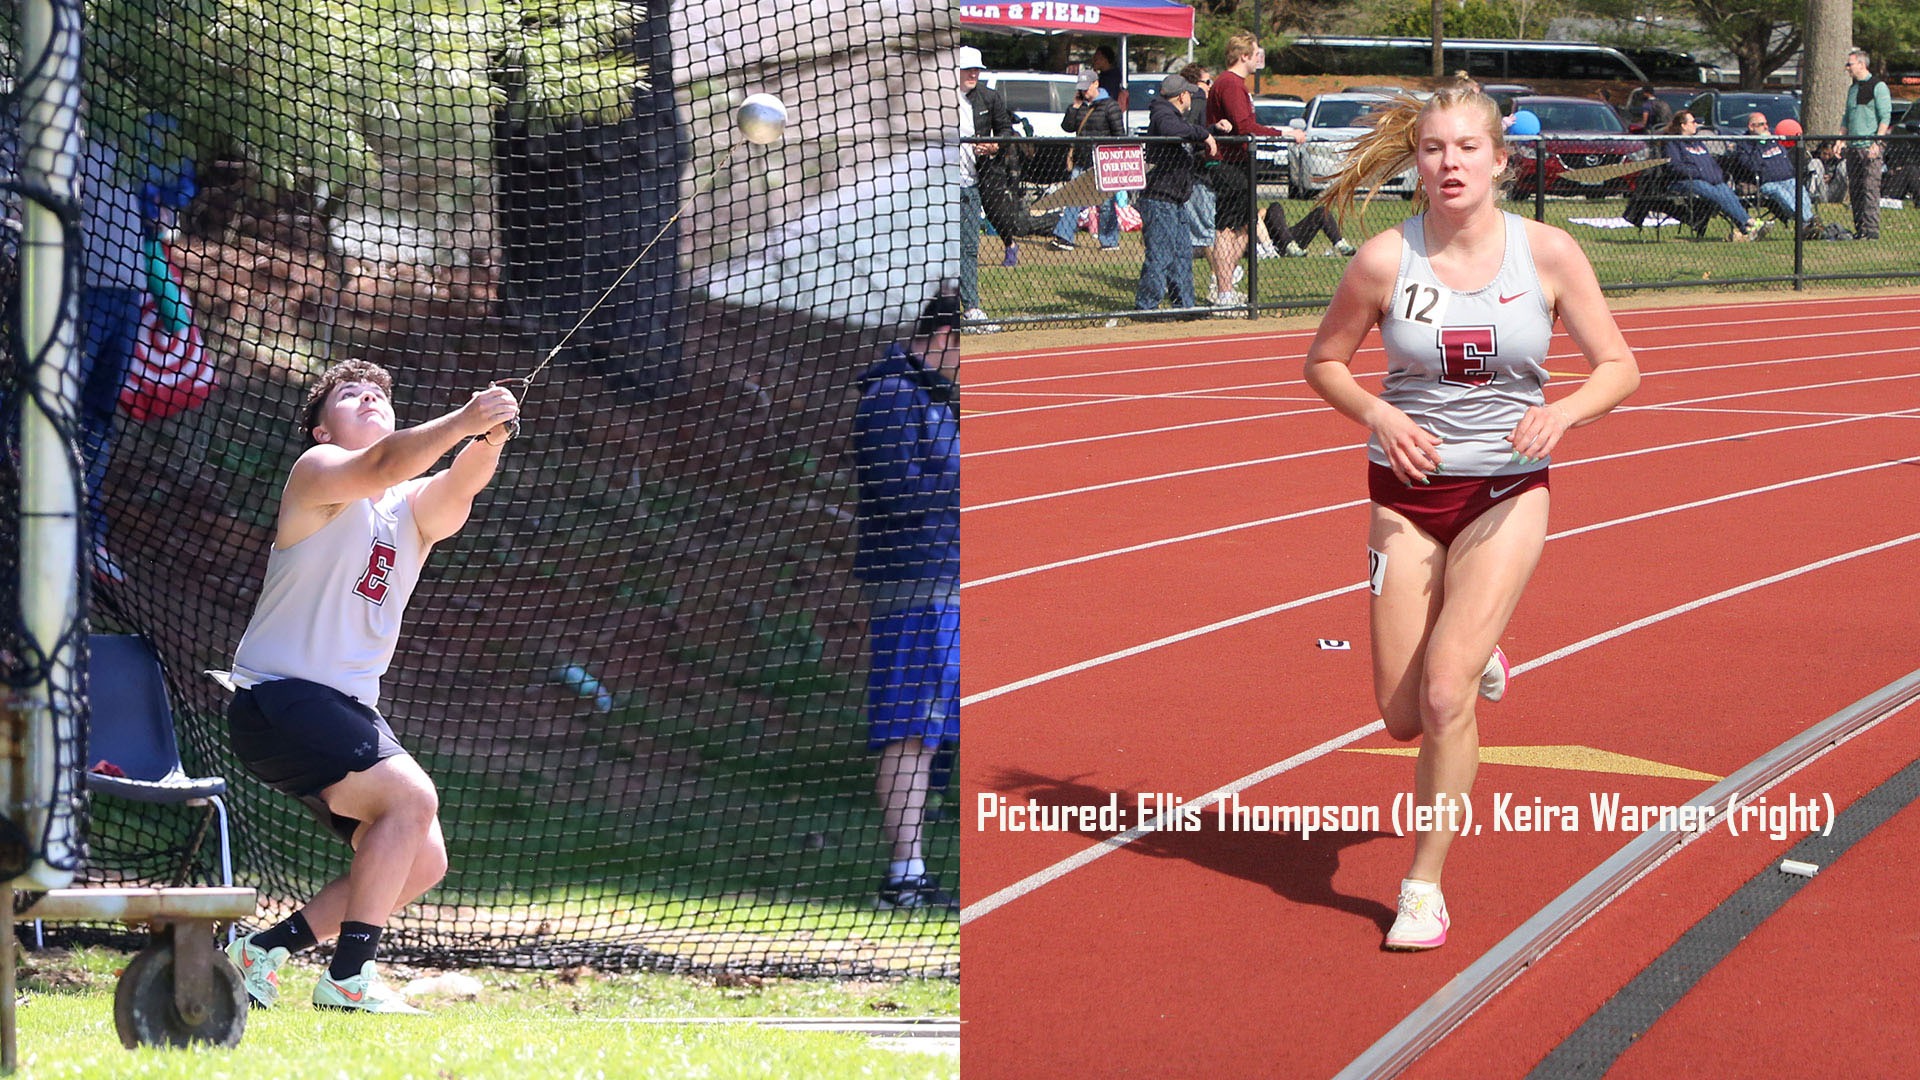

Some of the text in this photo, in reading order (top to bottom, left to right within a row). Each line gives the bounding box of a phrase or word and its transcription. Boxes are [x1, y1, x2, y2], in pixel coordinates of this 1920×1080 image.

[1008, 4, 1024, 20] &
[1031, 1, 1100, 24] FIELD
[1099, 150, 1141, 160] DO NOT JUMP
[1102, 161, 1140, 171] OVER FENCE
[1404, 282, 1440, 325] 12
[1436, 324, 1499, 389] E
[352, 536, 397, 607] E
